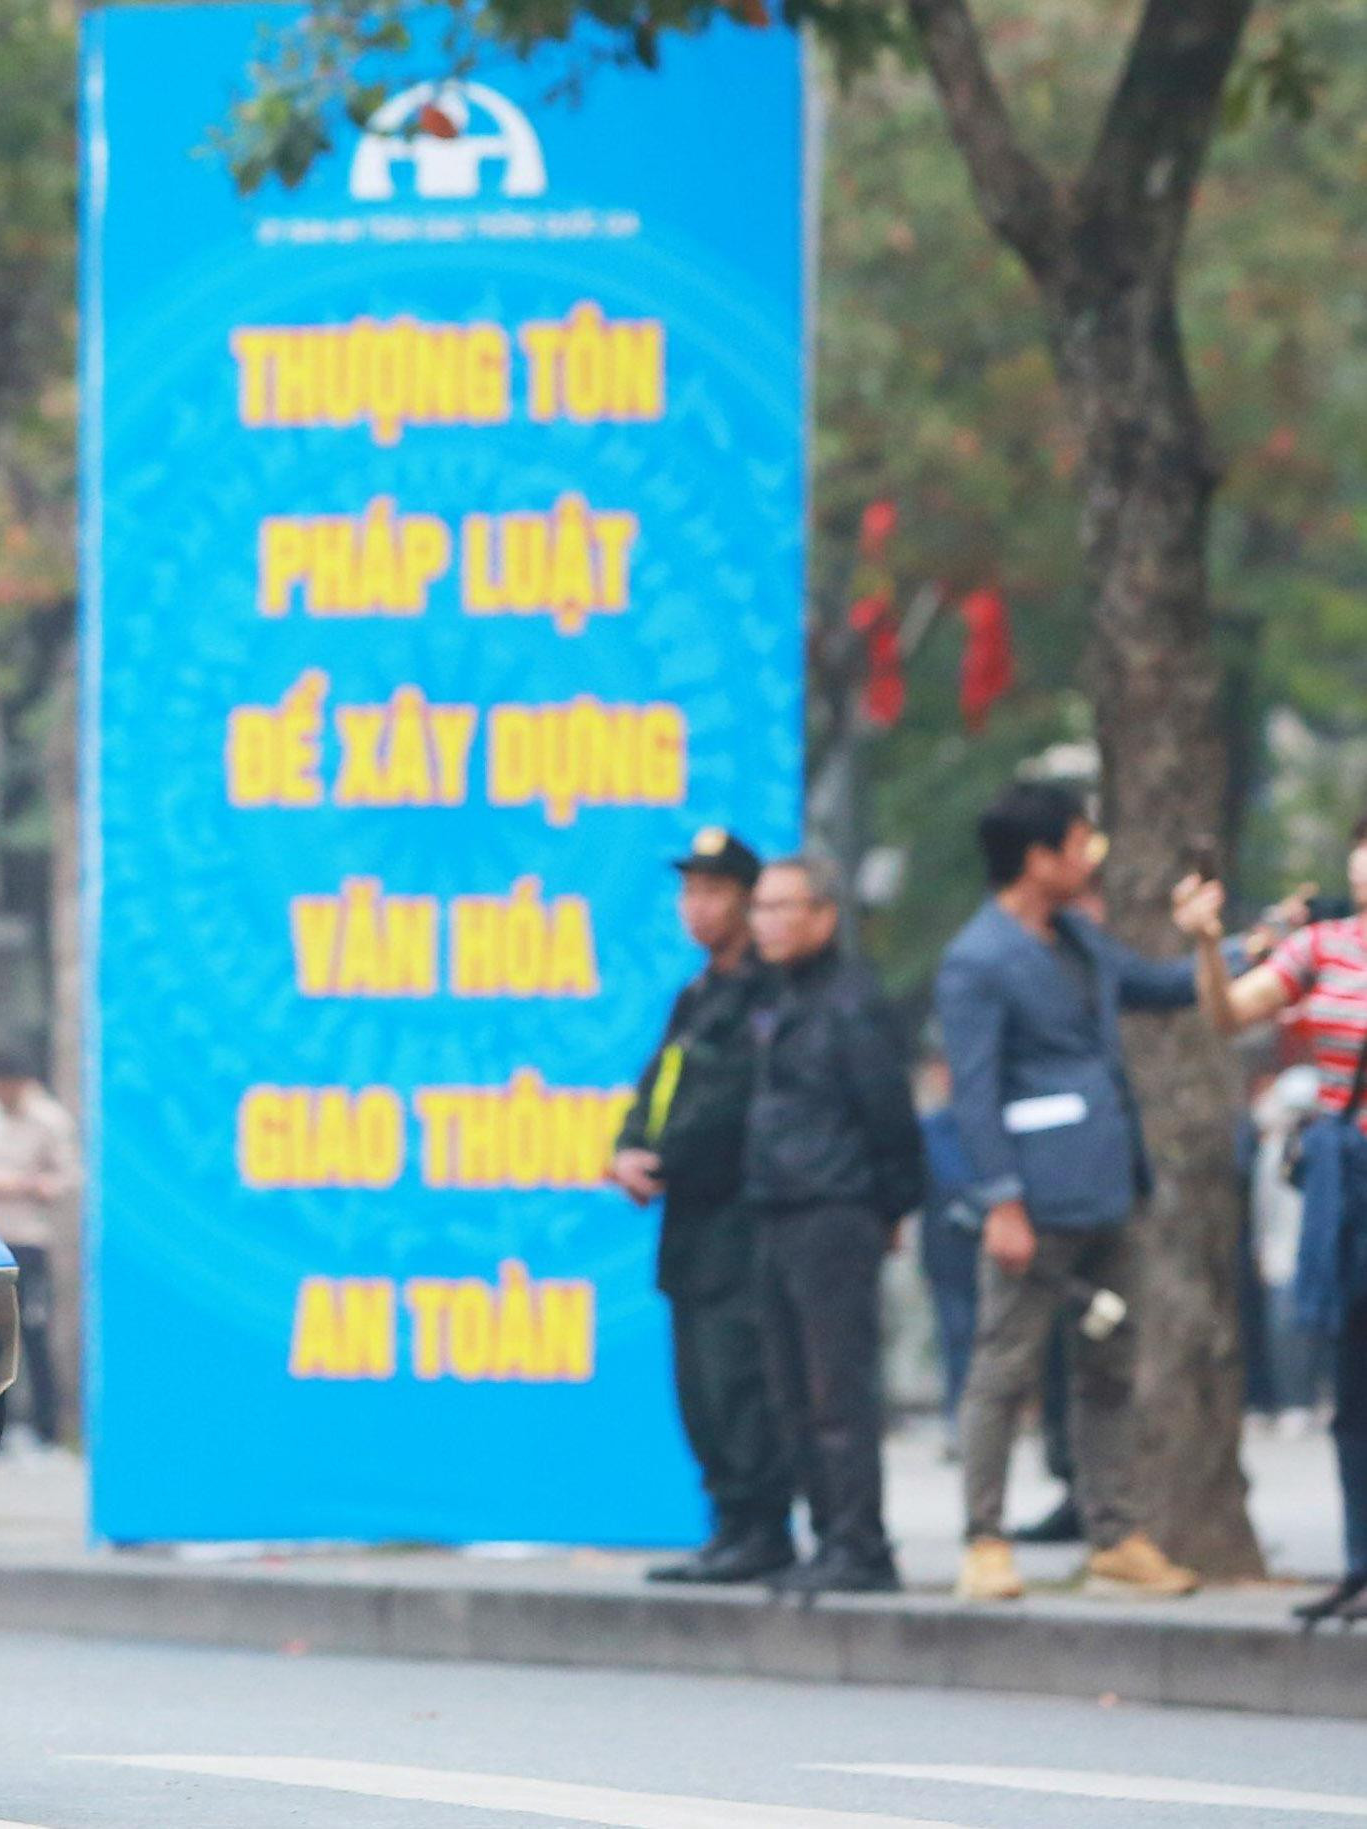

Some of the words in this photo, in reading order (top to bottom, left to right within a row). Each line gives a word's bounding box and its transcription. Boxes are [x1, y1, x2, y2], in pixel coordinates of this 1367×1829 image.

[233, 317, 509, 444] THƯỢNG
[520, 303, 664, 422] TÔN
[260, 497, 450, 615] PHÁP
[463, 494, 637, 633] LUẬT
[335, 687, 477, 805] XÂY
[488, 697, 686, 825] DỰNG
[292, 878, 438, 996] VĂN
[451, 877, 598, 997] HÓA
[239, 1086, 404, 1187] GIAO
[290, 1278, 395, 1379] AN
[405, 1261, 594, 1382] TOÀN
